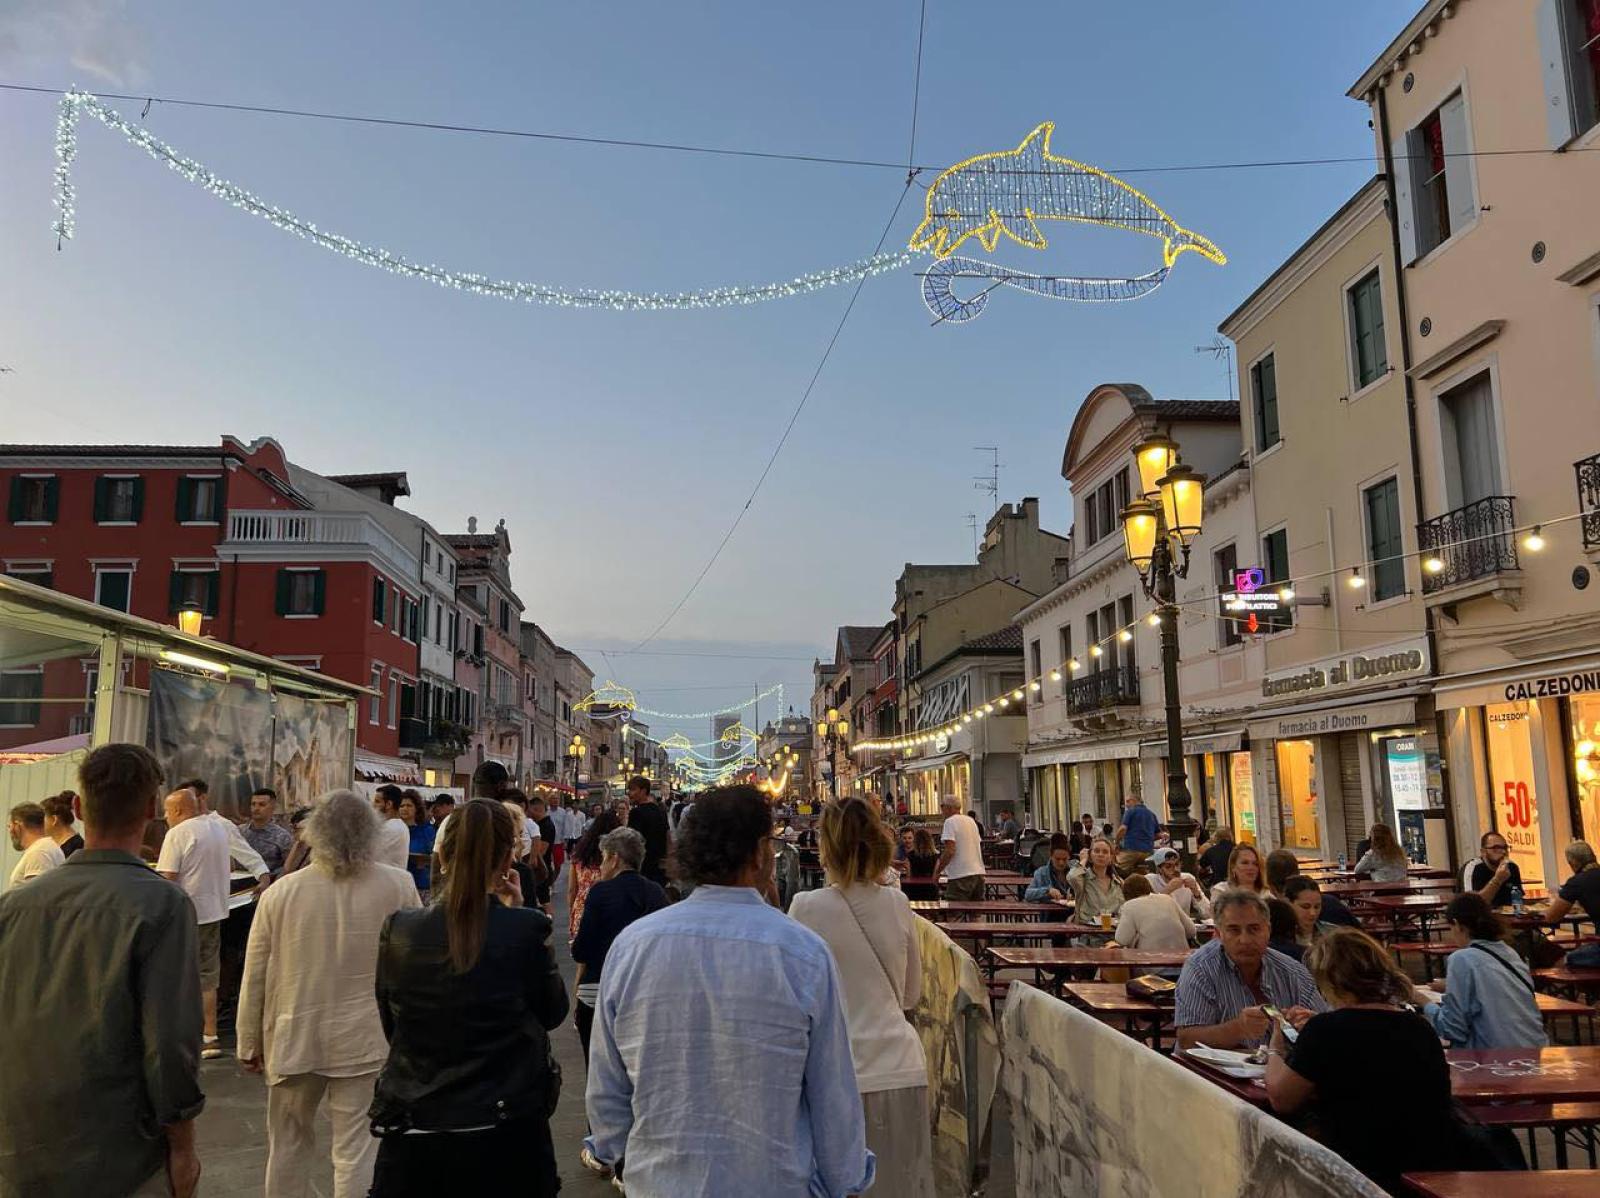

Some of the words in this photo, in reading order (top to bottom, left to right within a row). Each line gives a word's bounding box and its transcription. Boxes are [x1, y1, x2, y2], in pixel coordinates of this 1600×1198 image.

[1330, 660, 1348, 685] al
[1352, 650, 1422, 680] Duomo
[1278, 718, 1318, 735] farmacia
[1320, 718, 1329, 731] al
[1332, 714, 1367, 728] Duomo
[1507, 831, 1536, 847] SALDI
